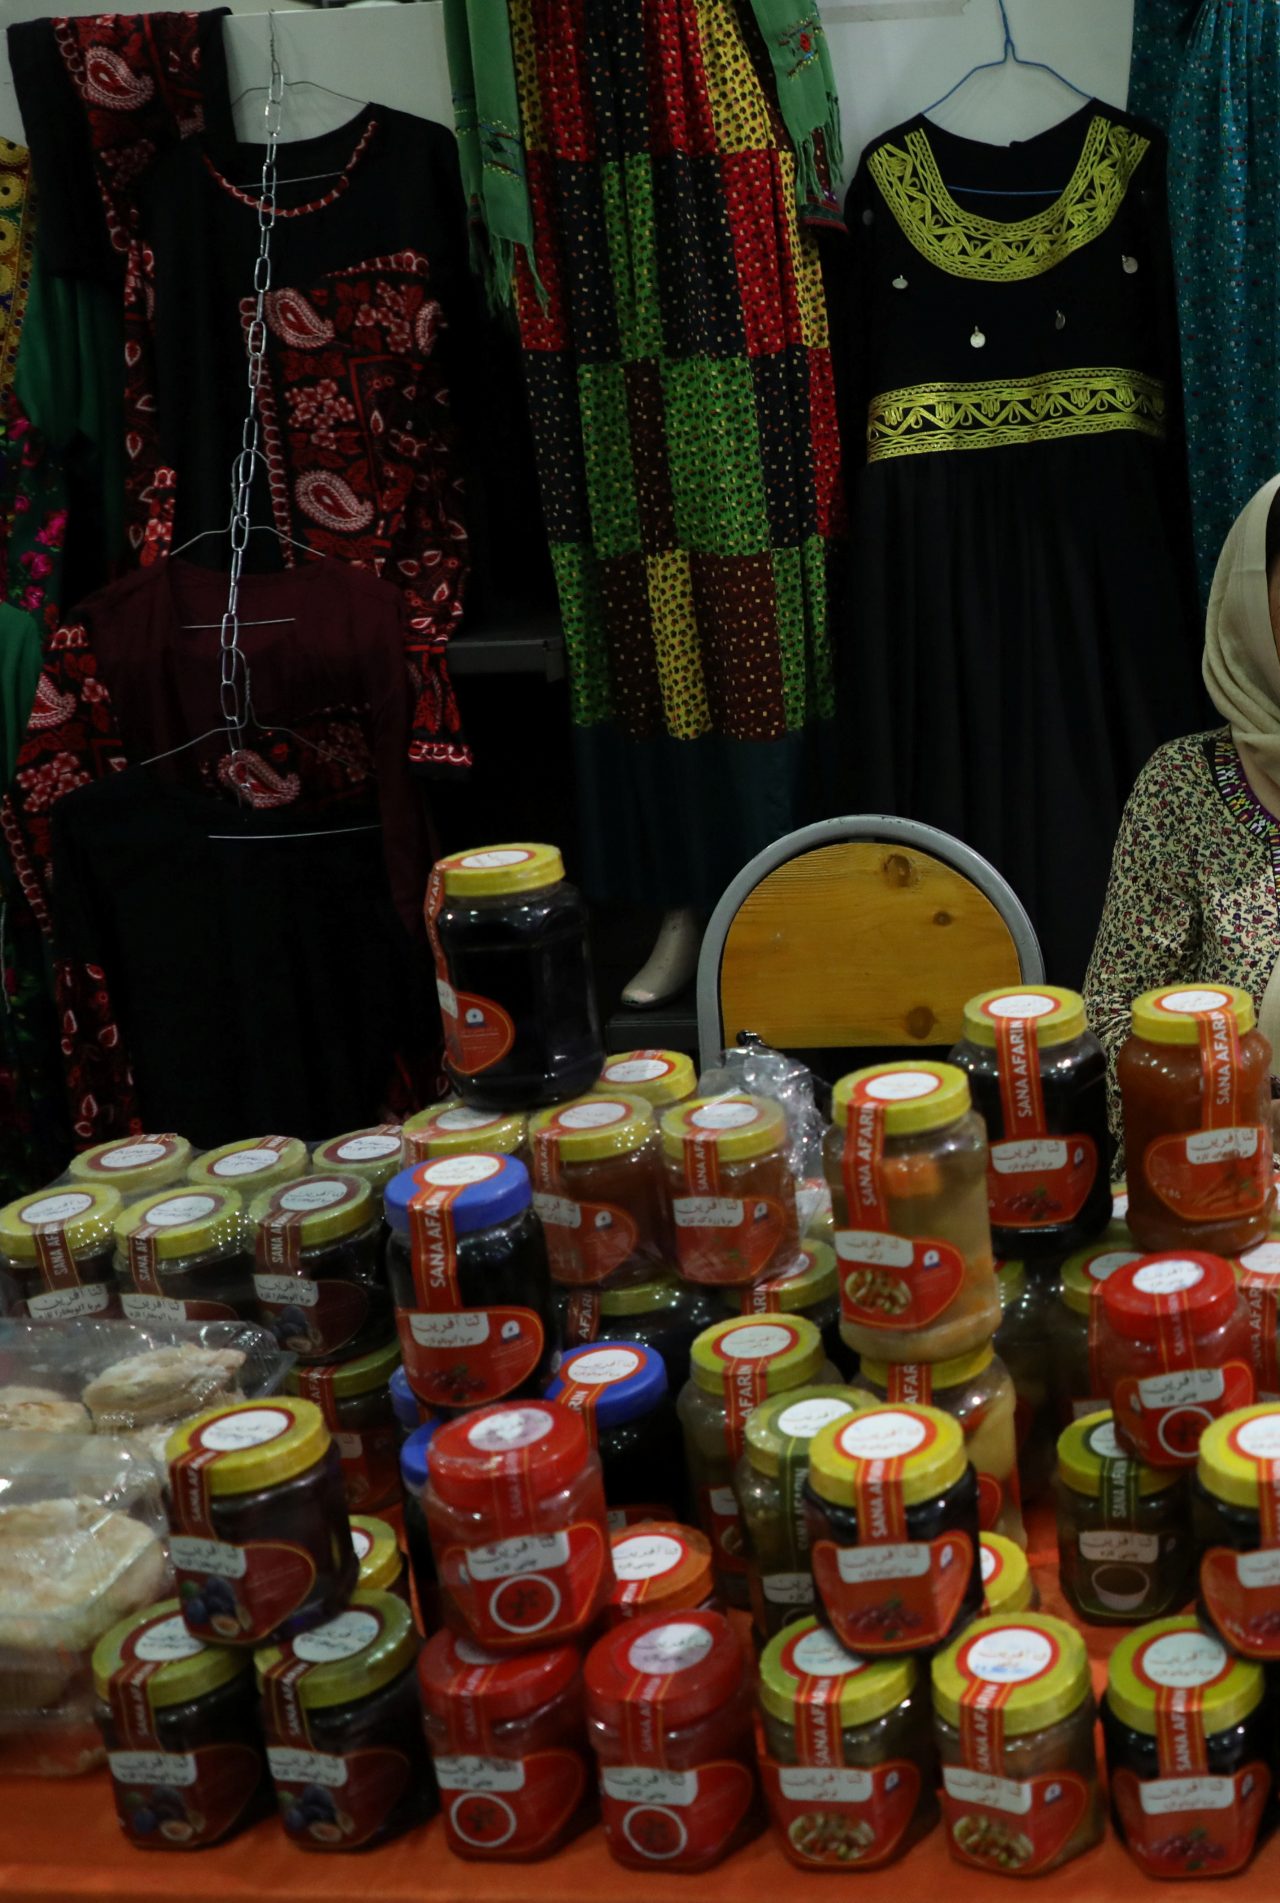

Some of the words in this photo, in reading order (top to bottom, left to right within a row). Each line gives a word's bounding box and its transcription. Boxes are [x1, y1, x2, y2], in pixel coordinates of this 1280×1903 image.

[1015, 1080, 1033, 1118] SANA
[1216, 1065, 1234, 1105] SANA
[858, 1164, 877, 1205] SANA
[50, 1248, 69, 1276] SANA
[138, 1254, 152, 1281] SANA
[271, 1236, 285, 1264] SANA
[427, 1242, 447, 1288] SANA
[577, 1291, 594, 1339] AFARI
[871, 1500, 888, 1538] SANA
[1111, 1491, 1127, 1519] SANA
[813, 1728, 830, 1766] SANA
